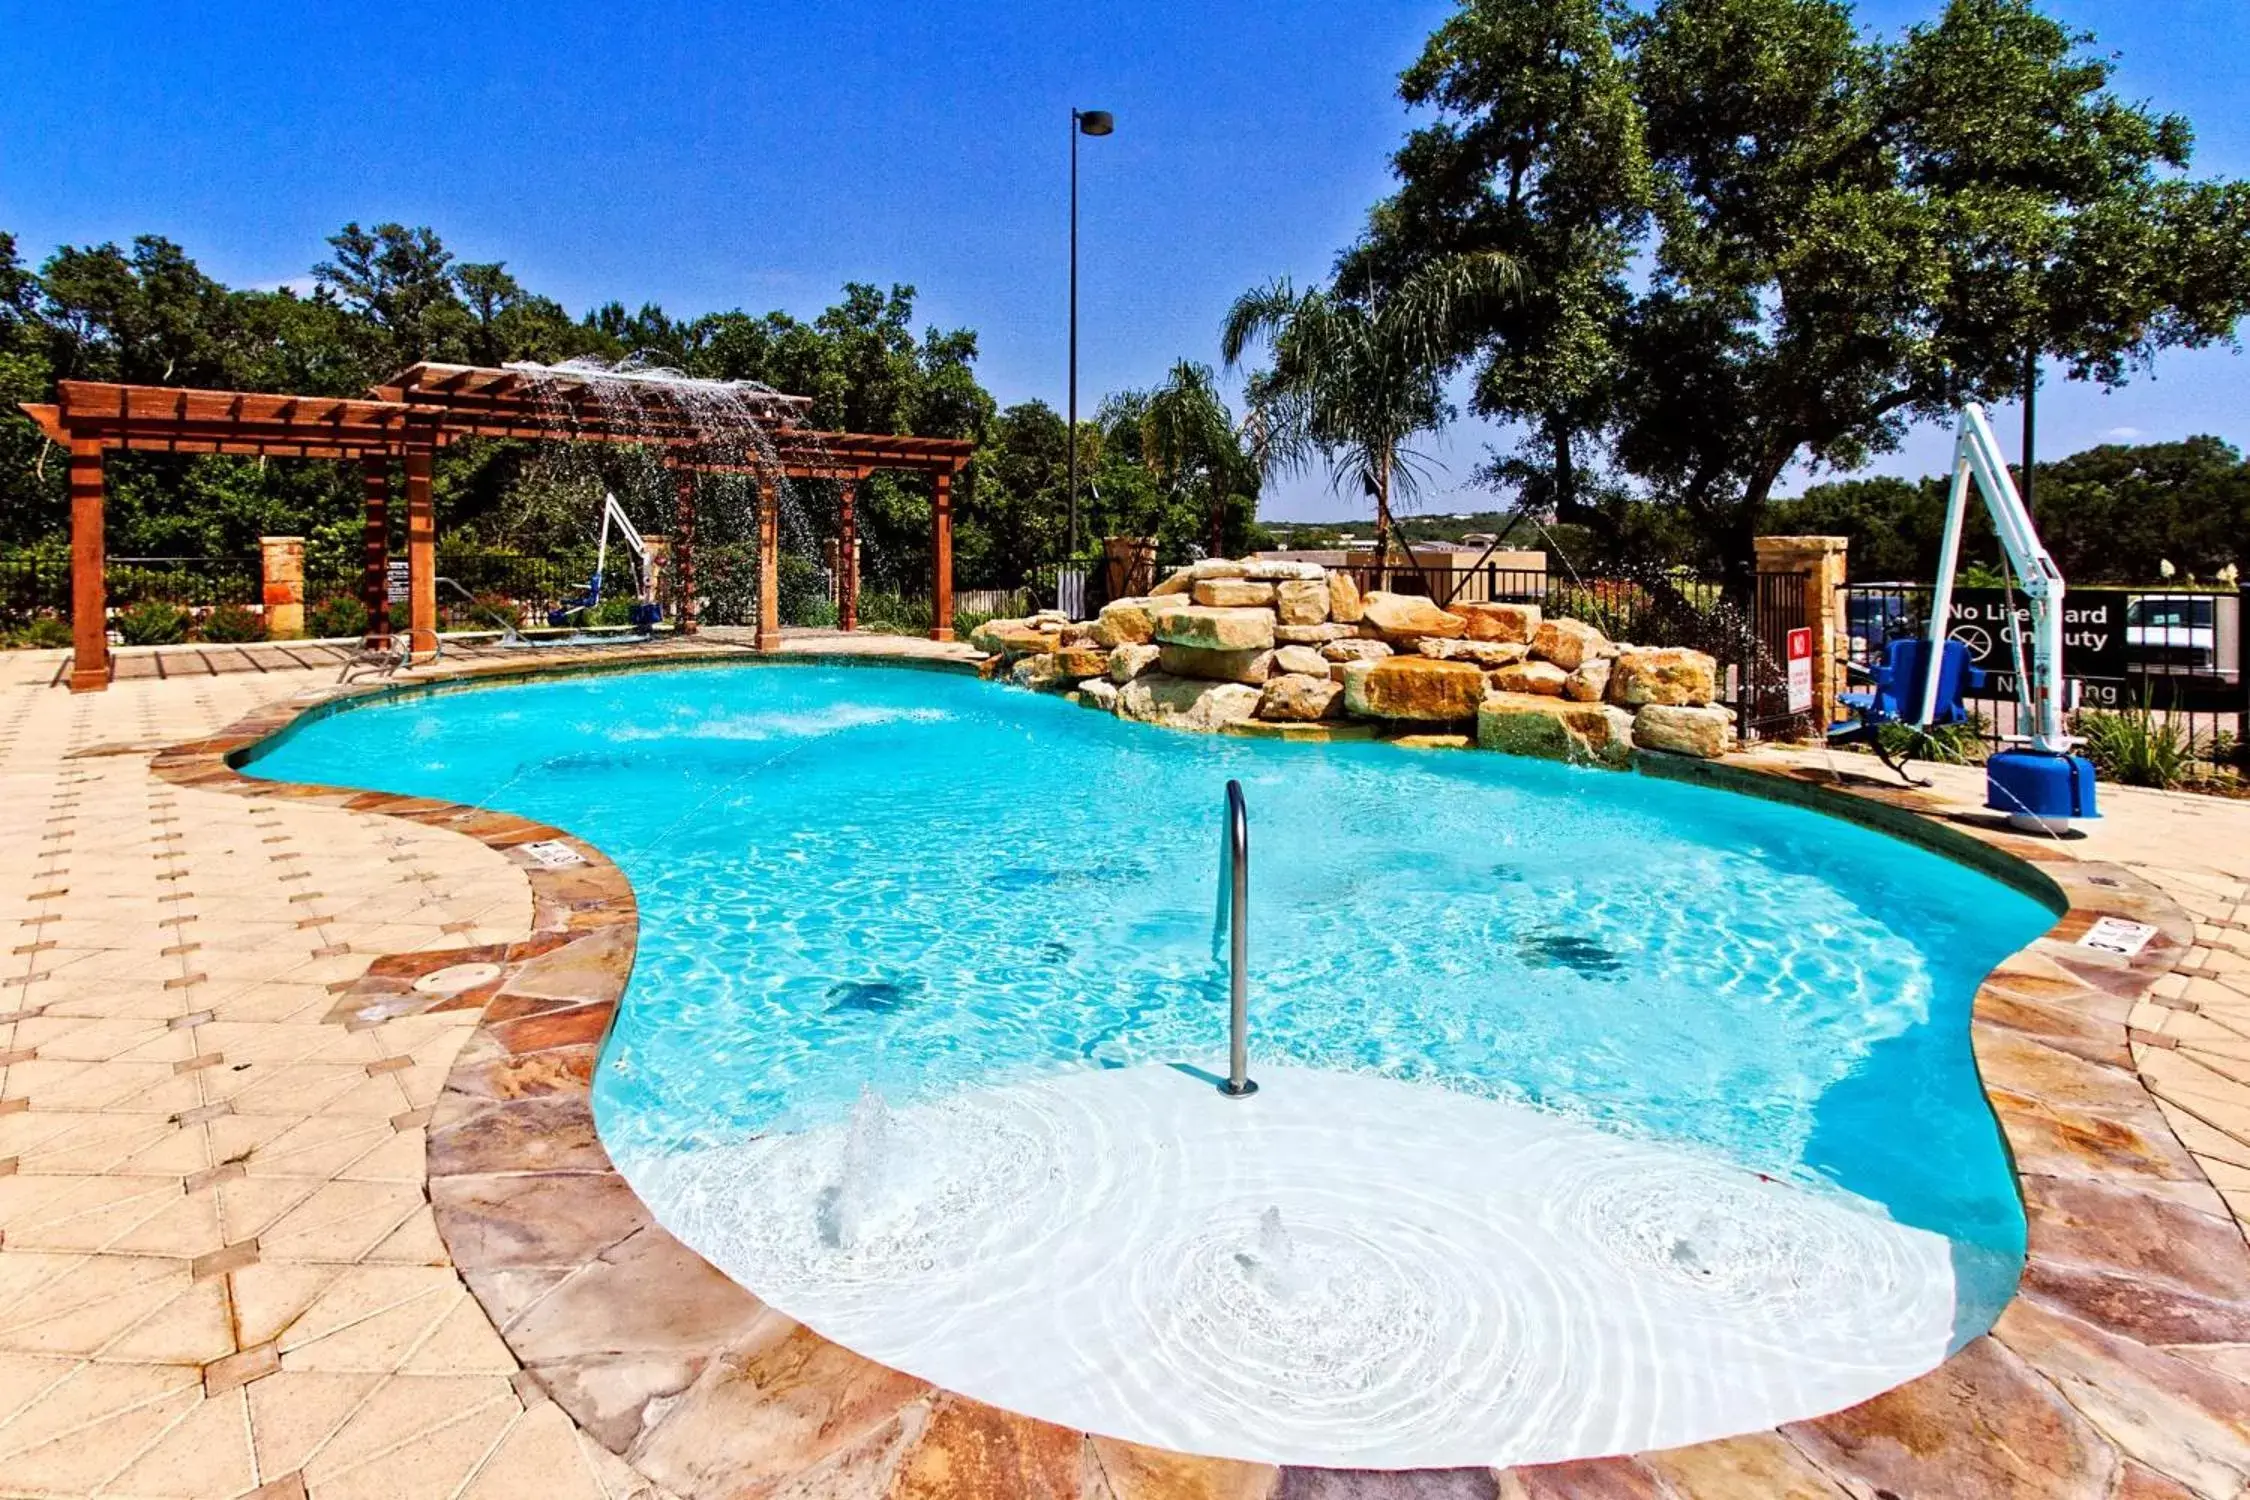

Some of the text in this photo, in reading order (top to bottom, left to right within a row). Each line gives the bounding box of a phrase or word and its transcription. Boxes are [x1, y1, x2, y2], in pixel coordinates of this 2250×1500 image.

[1950, 603, 2107, 624] No Lieard
[2064, 631, 2109, 652] uty
